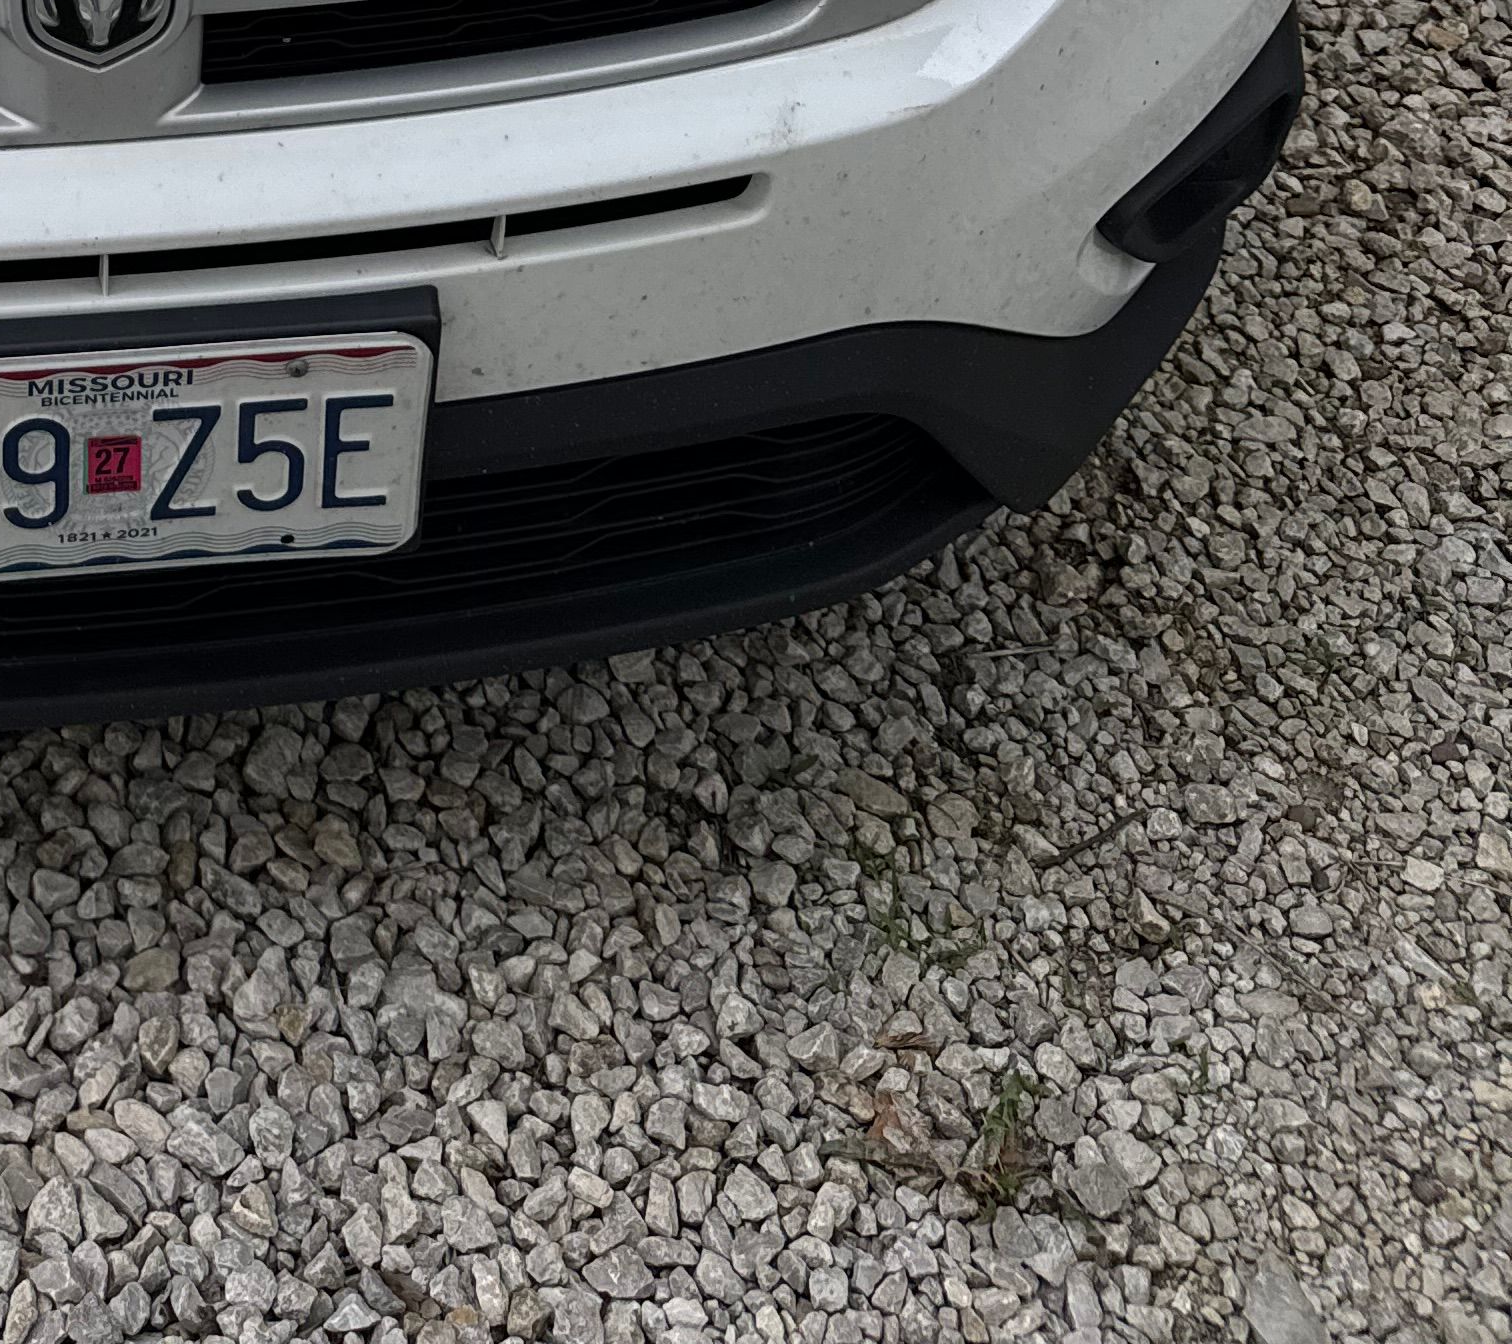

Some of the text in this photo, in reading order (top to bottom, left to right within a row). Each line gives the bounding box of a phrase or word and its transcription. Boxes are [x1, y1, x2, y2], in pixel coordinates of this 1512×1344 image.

[28, 369, 194, 397] MISSOURI
[41, 388, 180, 408] BICENTENNIAL
[95, 447, 130, 475] 27
[150, 394, 395, 521] Z5E
[58, 526, 158, 544] 1821 2021
